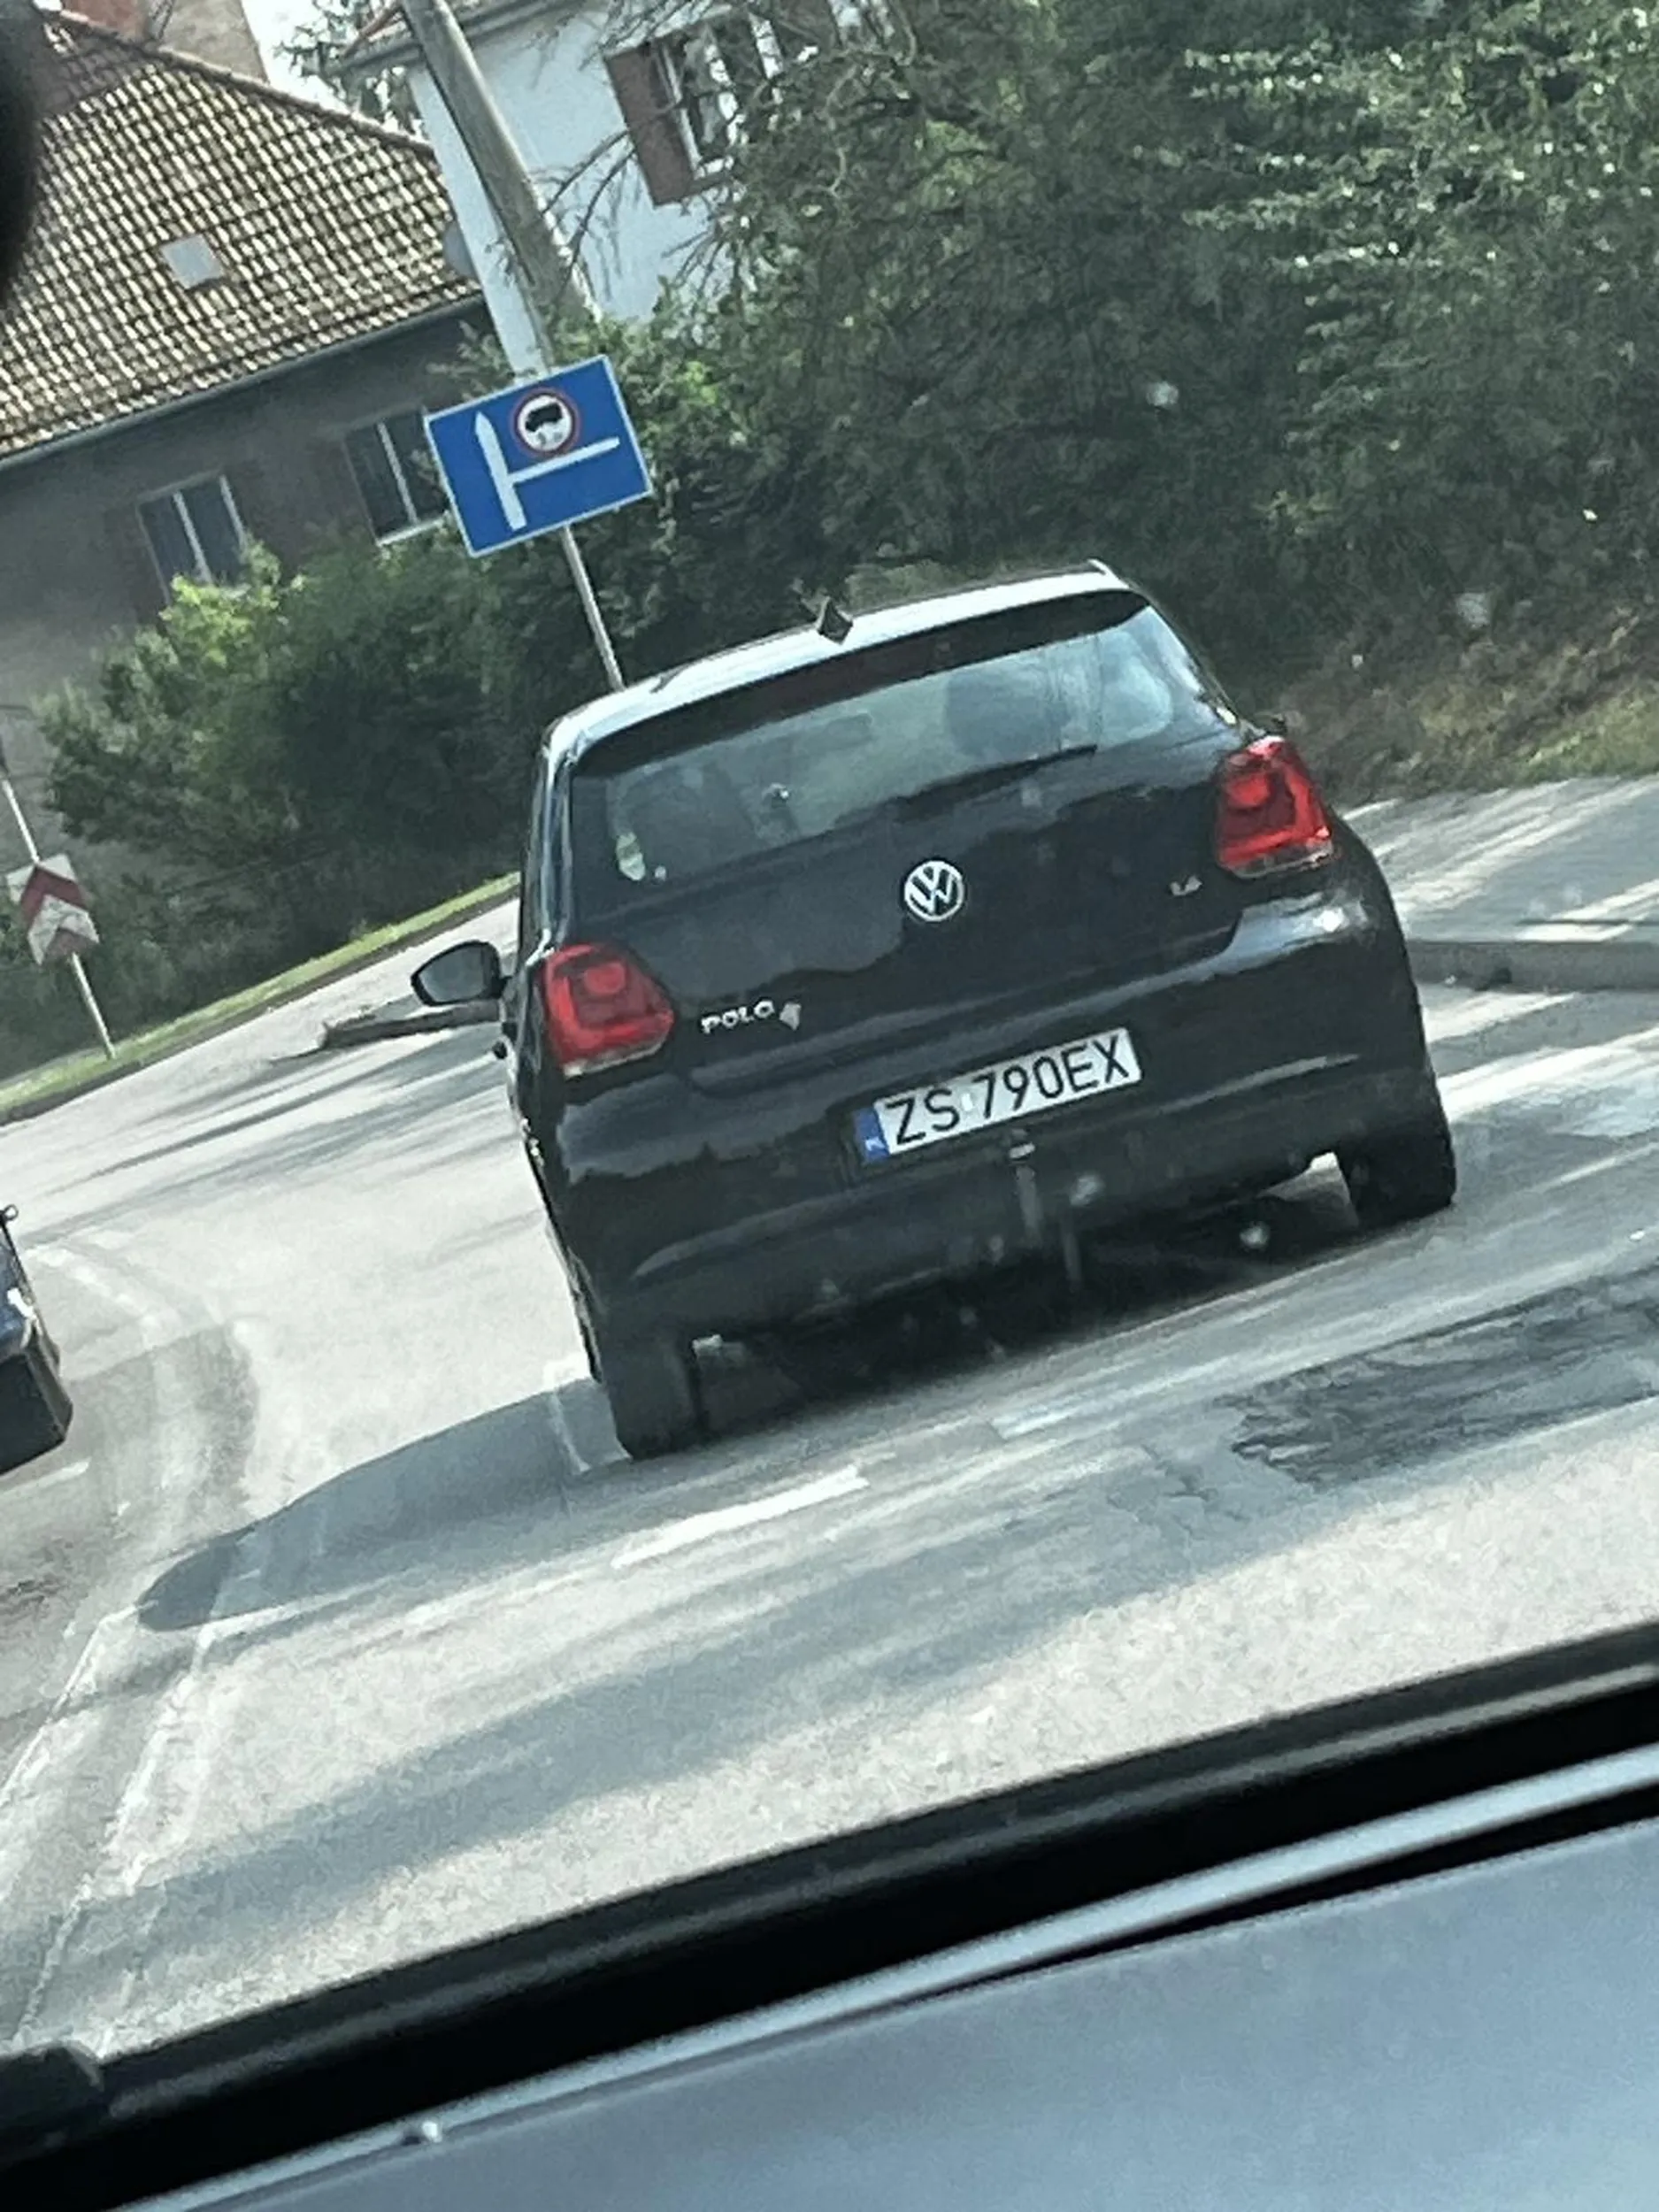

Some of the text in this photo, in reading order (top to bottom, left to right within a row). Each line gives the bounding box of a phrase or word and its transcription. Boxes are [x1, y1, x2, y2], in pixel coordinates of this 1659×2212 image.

[700, 1000, 775, 1035] POLO
[885, 1033, 1130, 1146] ZS 790EX
